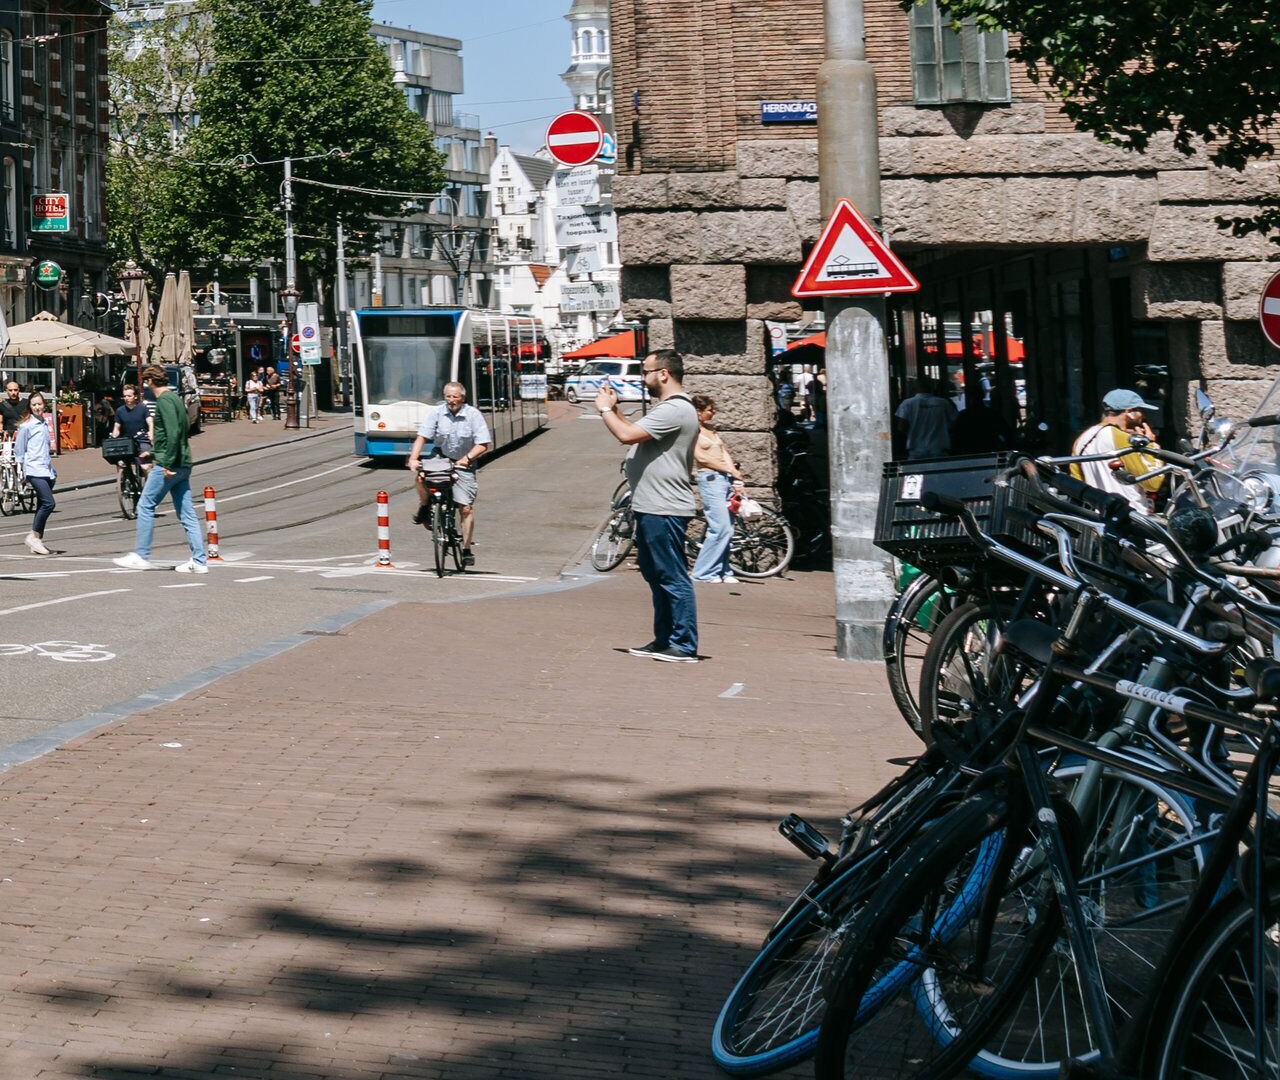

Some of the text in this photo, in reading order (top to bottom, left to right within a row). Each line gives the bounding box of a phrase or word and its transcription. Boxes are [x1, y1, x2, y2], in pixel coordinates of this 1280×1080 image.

[39, 197, 60, 205] CITY
[35, 204, 64, 212] HOTEL
[566, 228, 608, 236] toepassing
